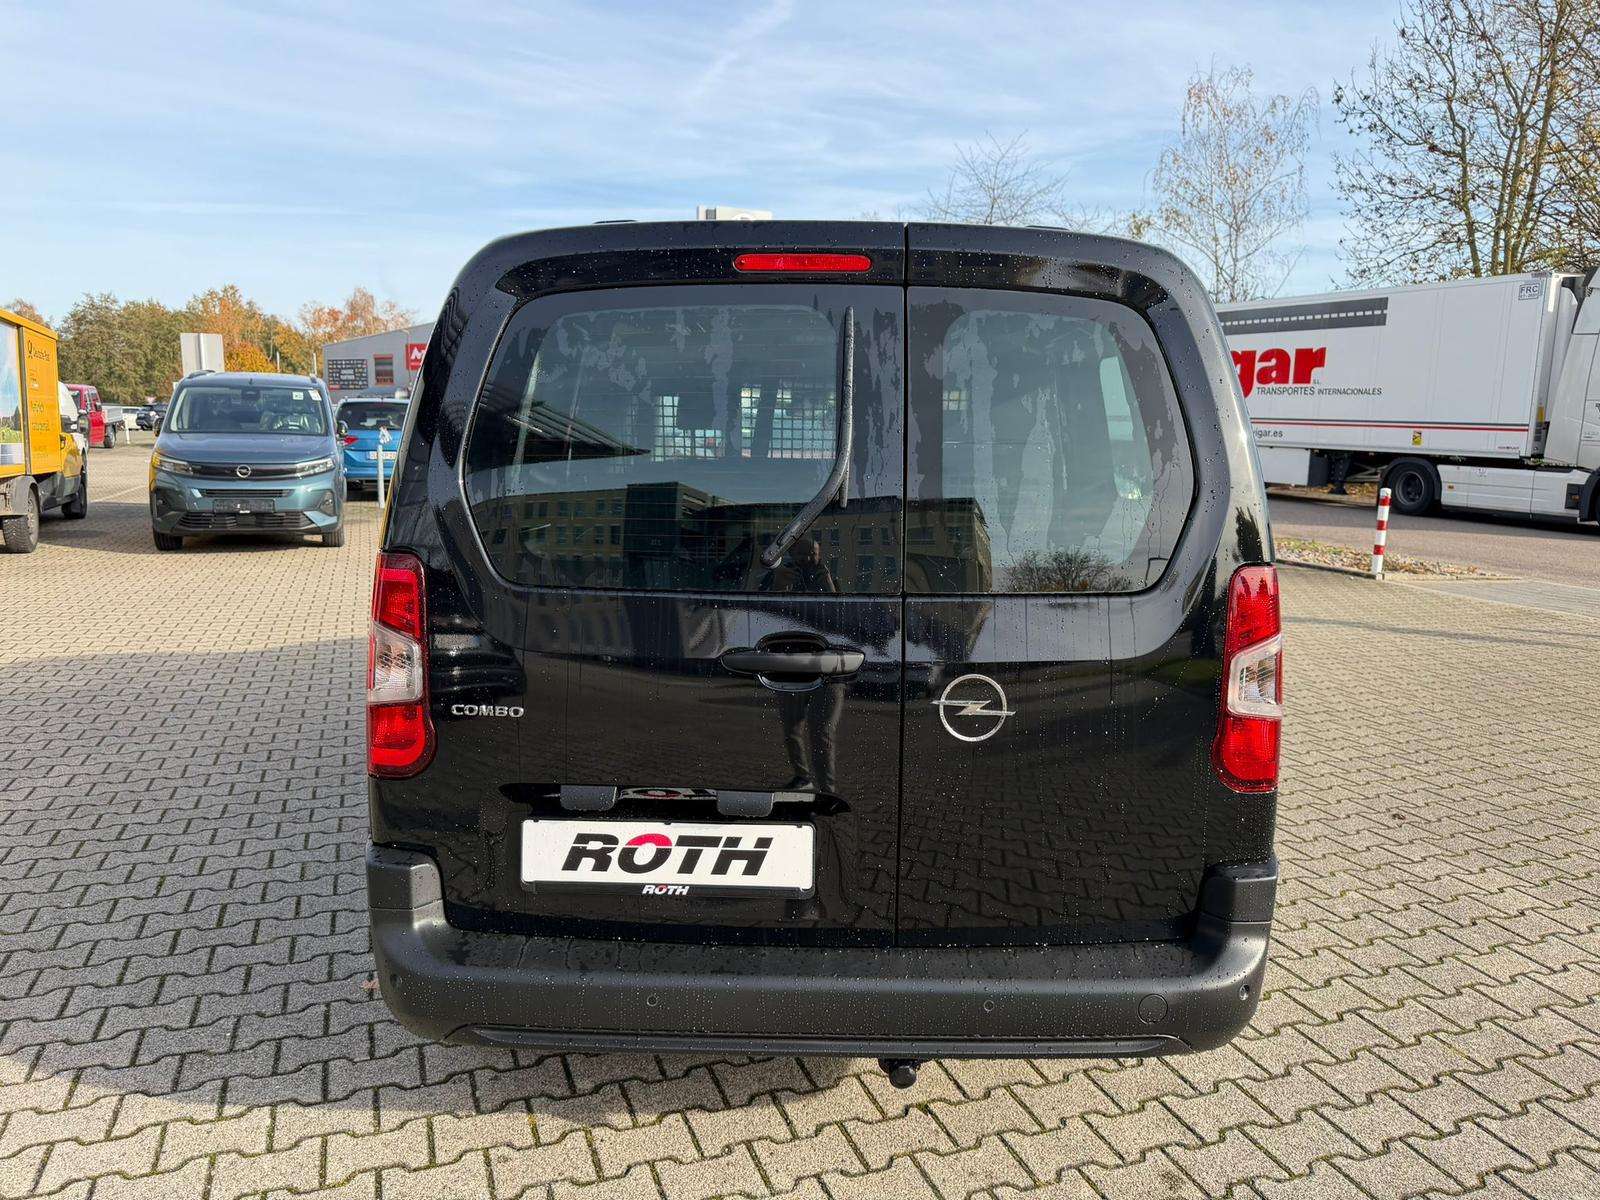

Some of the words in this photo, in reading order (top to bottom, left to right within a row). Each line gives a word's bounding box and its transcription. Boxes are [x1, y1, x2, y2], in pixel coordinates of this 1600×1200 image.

[1520, 285, 1538, 294] FRC
[1256, 386, 1315, 396] TRANSPORTES
[1317, 387, 1383, 396] INTERNACIONALES
[451, 704, 525, 718] COMBO
[561, 832, 774, 876] ROTH
[641, 884, 690, 896] ROTH
